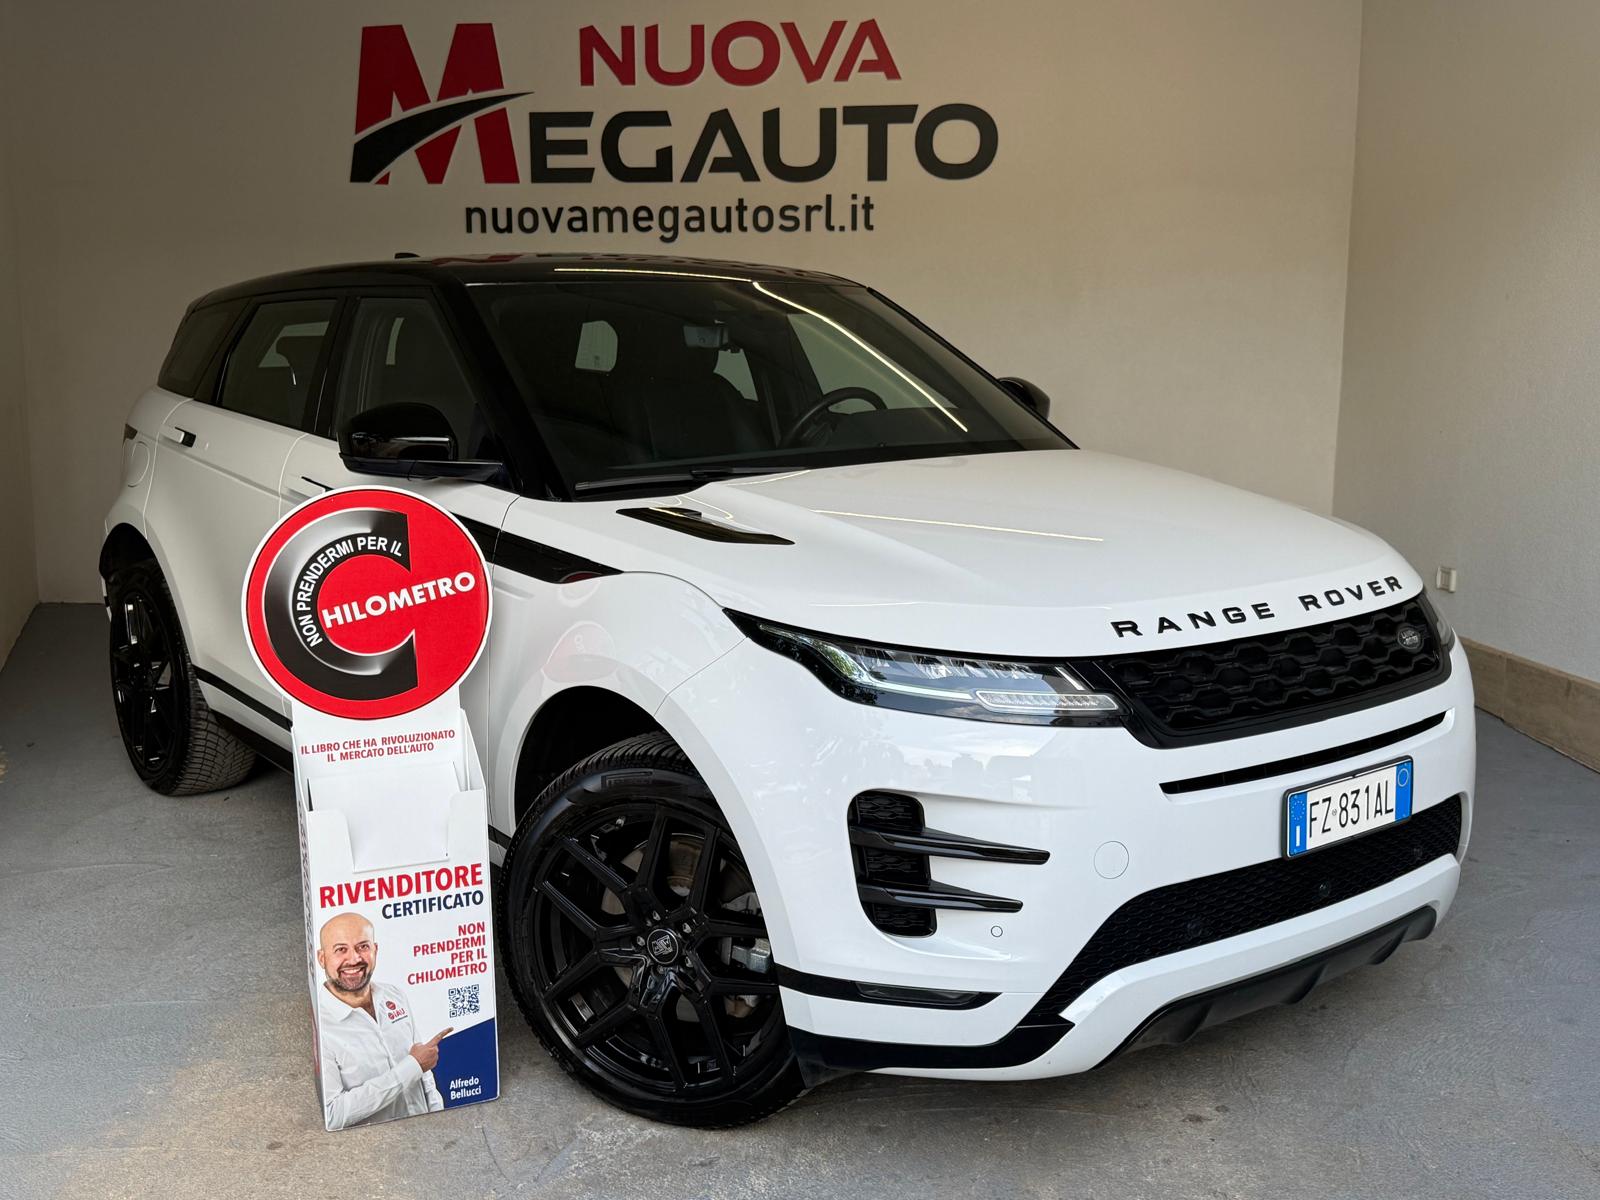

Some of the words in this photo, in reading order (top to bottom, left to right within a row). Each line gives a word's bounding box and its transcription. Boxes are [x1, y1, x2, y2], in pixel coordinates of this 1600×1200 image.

[579, 19, 902, 87] NUOVA
[349, 22, 999, 186] MEGAUTO
[465, 193, 875, 243] nuovamegautosrl.it
[357, 536, 388, 552] PER
[389, 540, 403, 557] IL
[296, 539, 355, 612] PRENDERMI
[321, 571, 476, 629] HILOMETRO
[1110, 602, 1275, 638] RANGE
[1297, 575, 1403, 612] ROVER
[298, 615, 323, 648] NON
[301, 745, 311, 755] IL
[311, 741, 341, 754] LIBRO
[342, 738, 362, 750] CHE
[363, 737, 377, 748] HA
[381, 729, 456, 746] RIVOLUZIONATO
[327, 753, 336, 763] IL
[339, 747, 385, 761] MERCATO
[386, 741, 435, 757] DELL'AUTO
[1309, 796, 1332, 838] FZ
[1338, 780, 1394, 828] 831AL
[319, 863, 483, 909] RIVENDITORE
[381, 890, 484, 920] CERTIFICATO
[457, 922, 486, 936] NON
[412, 935, 487, 957] PRENDERMI
[450, 951, 475, 965] PER
[475, 948, 488, 960] IL
[407, 962, 488, 986] CHILOMETRO
[449, 1076, 480, 1090] Alfredo
[450, 1085, 482, 1101] Bellucci
